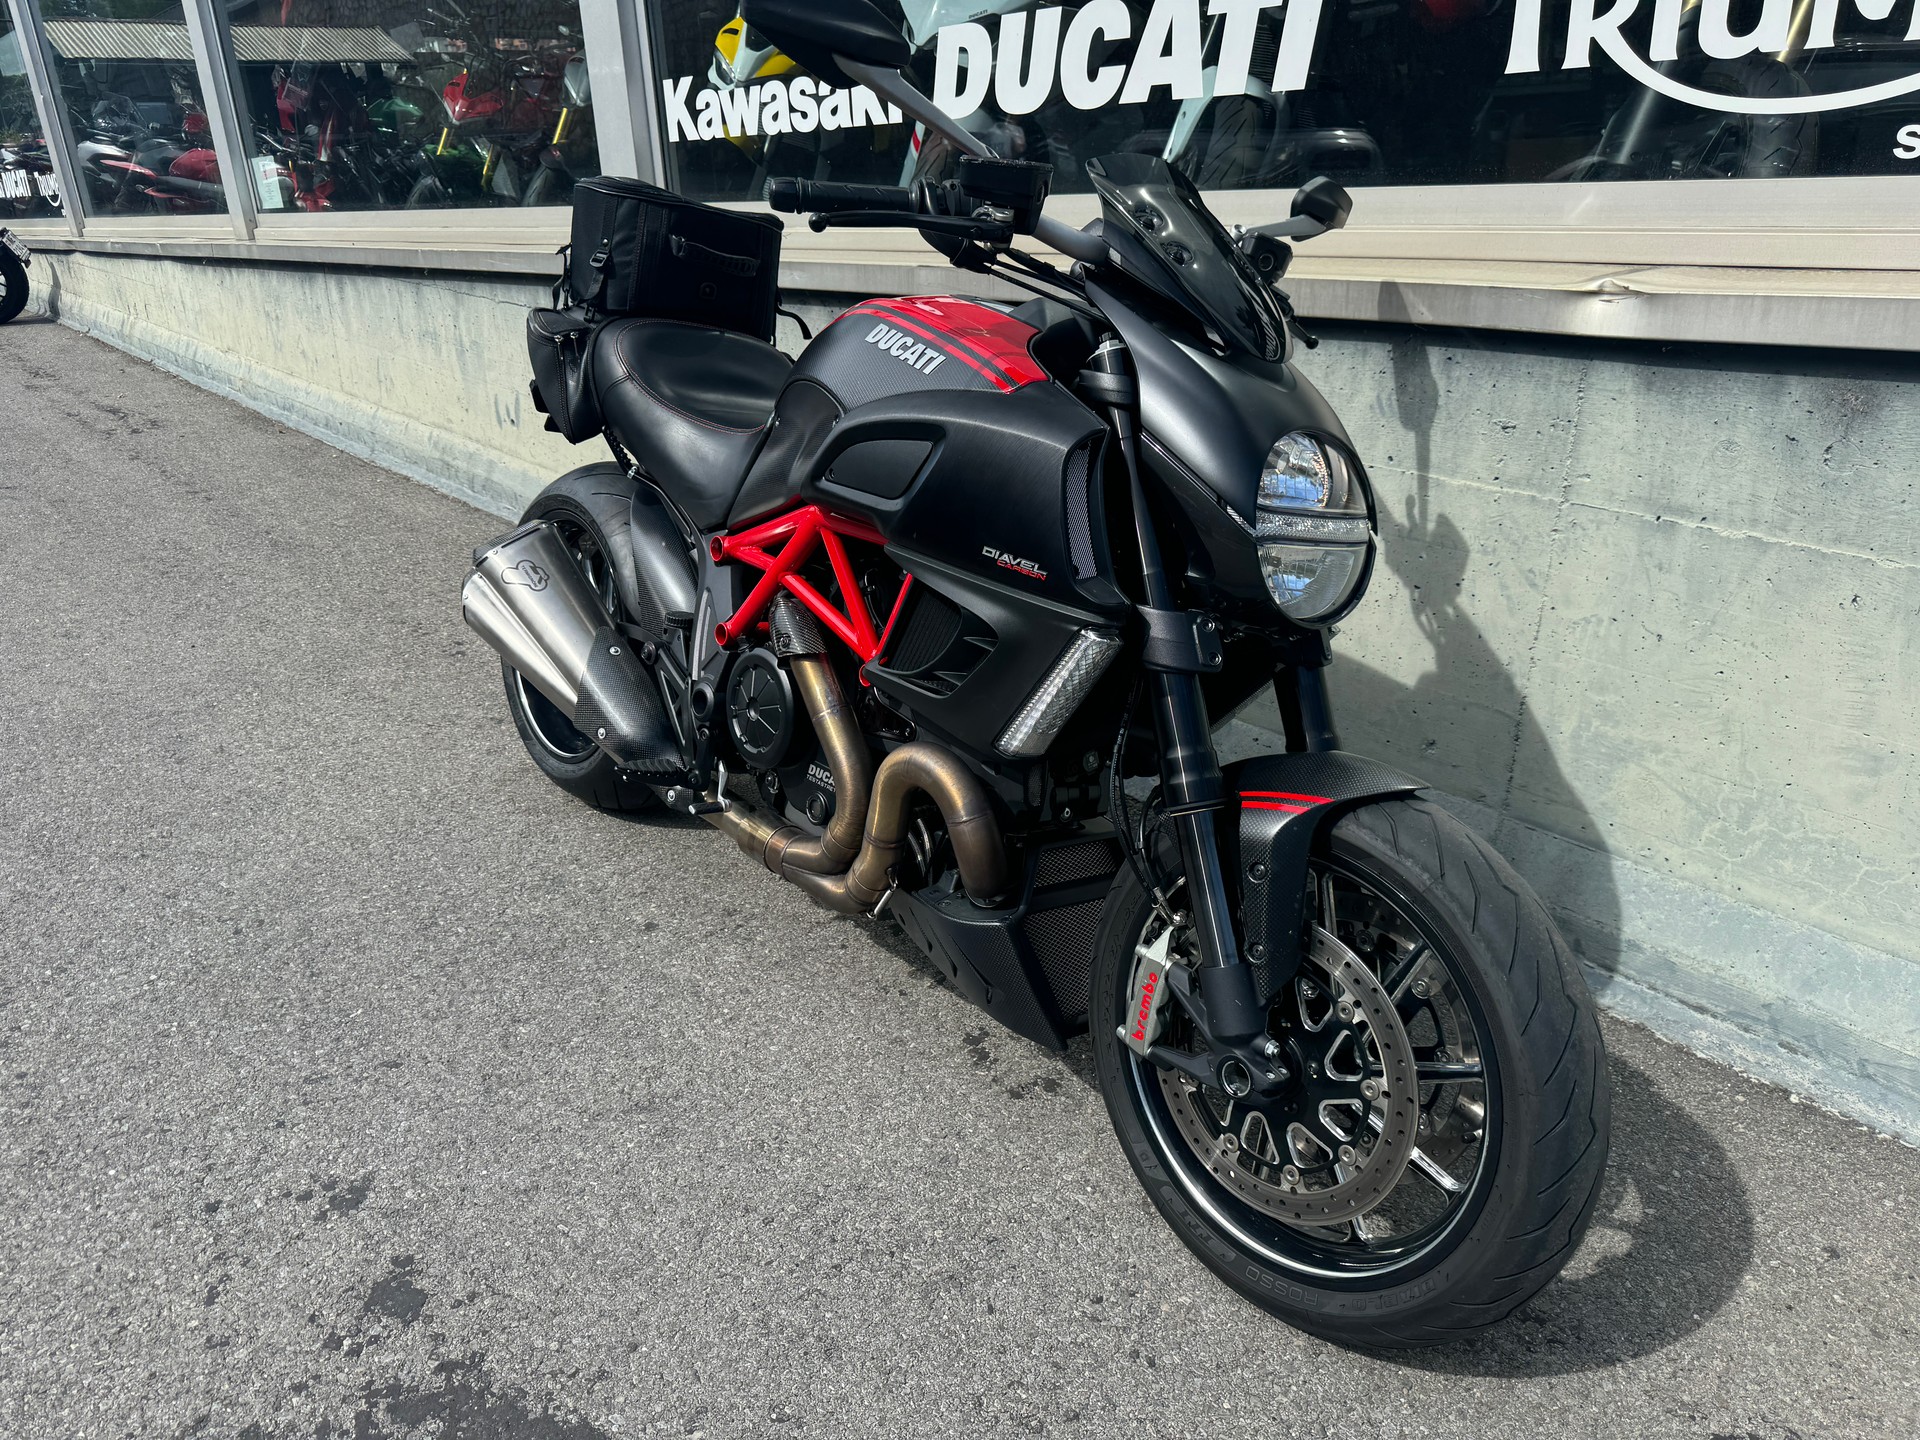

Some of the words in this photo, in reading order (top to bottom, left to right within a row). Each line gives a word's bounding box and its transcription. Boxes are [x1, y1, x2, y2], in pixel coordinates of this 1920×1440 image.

[933, 0, 1323, 120] DUCATI
[864, 323, 947, 375] DUCATI
[982, 545, 1048, 576] DIAVEL
[996, 560, 1047, 581] CARBON
[808, 763, 836, 786] DUCA
[1131, 972, 1158, 1041] brembo
[1245, 1265, 1319, 1306] ROSSO
